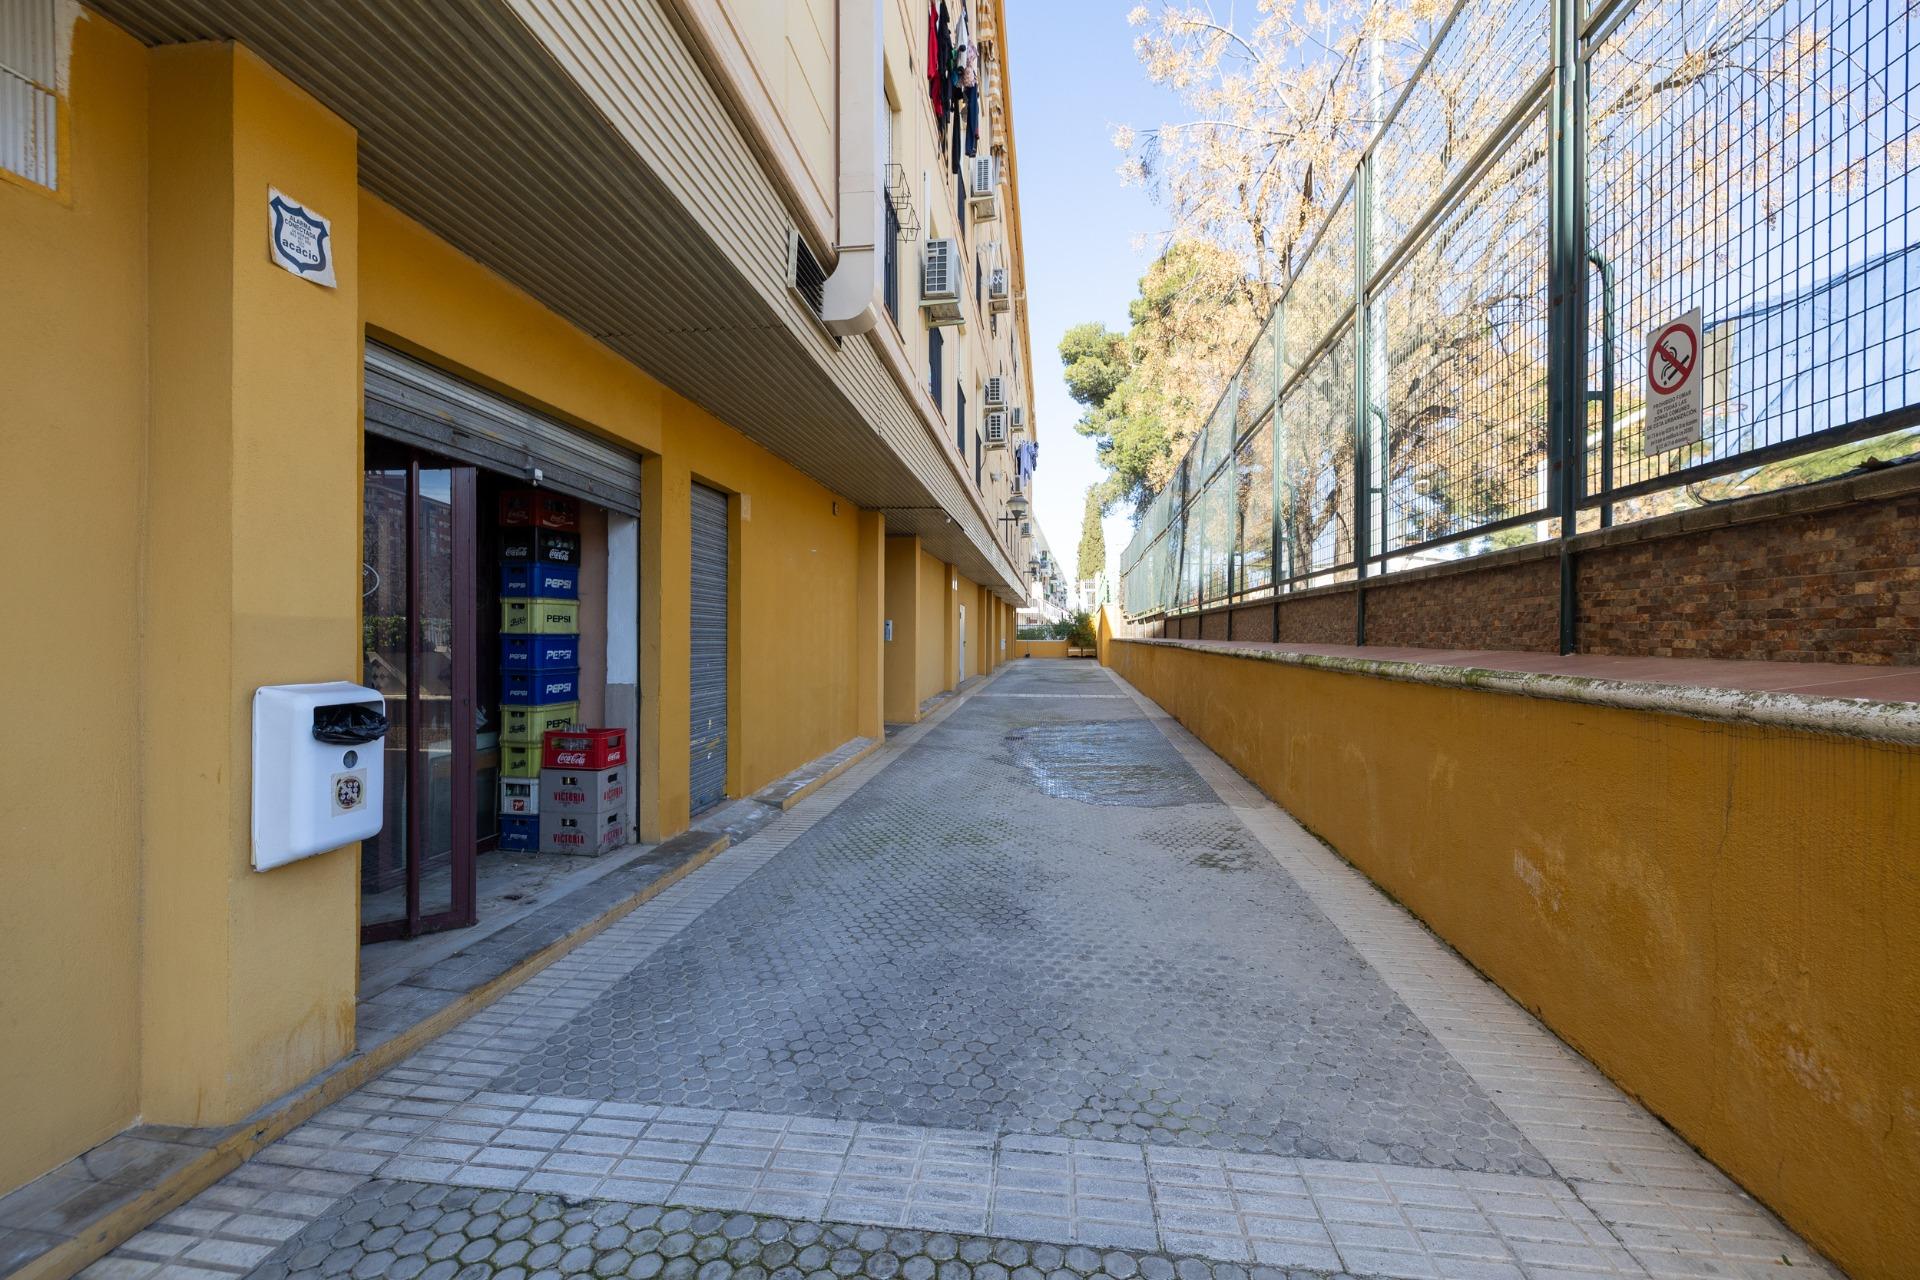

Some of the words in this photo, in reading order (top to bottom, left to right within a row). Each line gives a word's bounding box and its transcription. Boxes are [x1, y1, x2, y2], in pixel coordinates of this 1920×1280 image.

[290, 215, 311, 231] ALARMA
[285, 218, 317, 240] CONECTADA
[282, 239, 318, 262] acacio
[1676, 390, 1691, 400] FUMAR
[545, 577, 571, 589] PEPSI
[546, 614, 571, 623] PEPSI
[546, 650, 571, 660] PEPSI
[546, 683, 571, 694] PEPSI
[546, 717, 571, 728] PEPSI
[554, 791, 585, 802] VICTORIA
[553, 833, 584, 844] VICTORIA
